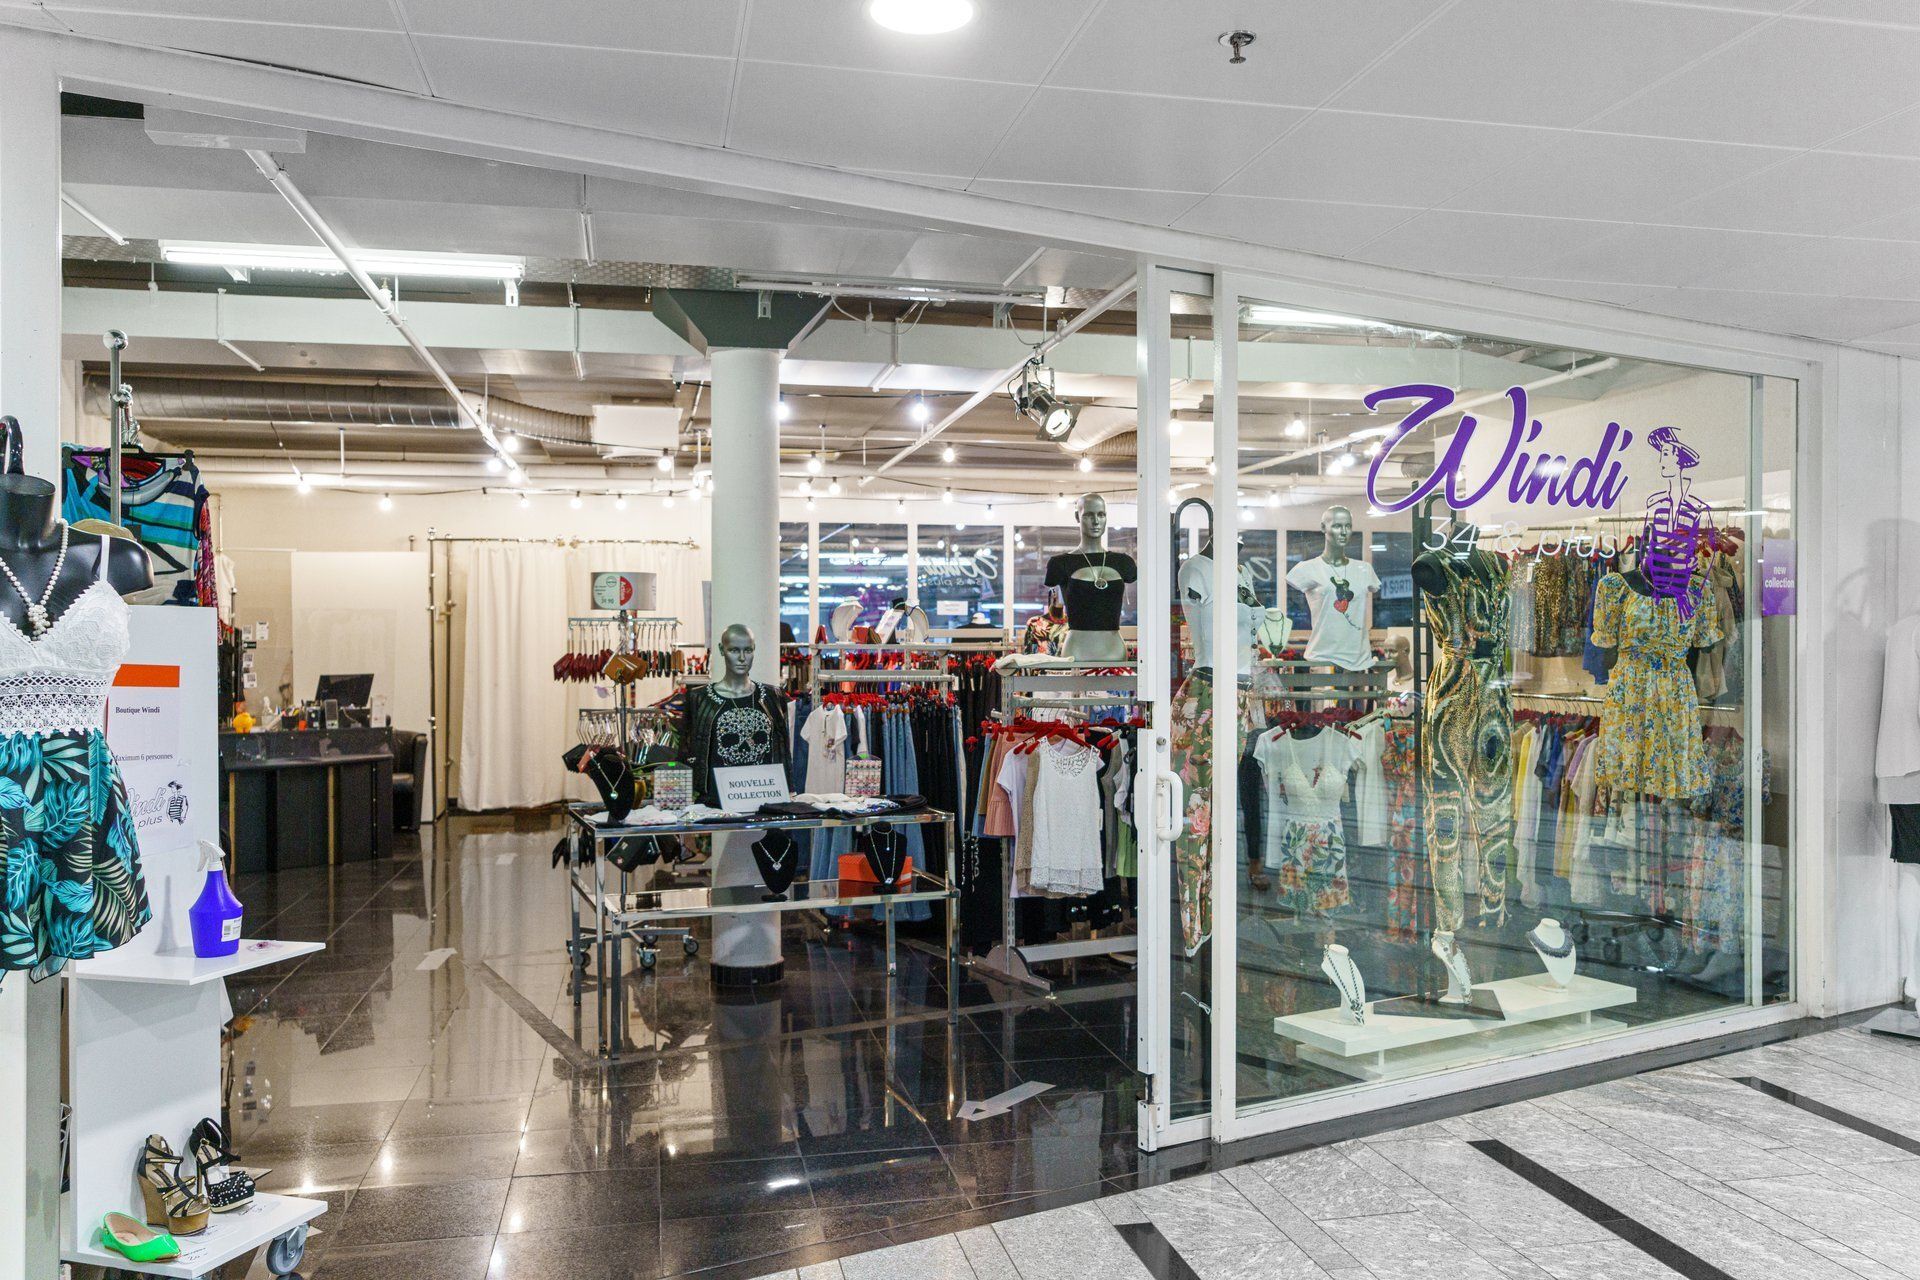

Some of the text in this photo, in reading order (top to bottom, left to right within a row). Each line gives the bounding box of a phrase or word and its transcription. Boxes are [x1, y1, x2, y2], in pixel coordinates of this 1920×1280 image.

[1421, 516, 1619, 562] 34 & plus
[1773, 566, 1787, 575] new
[1764, 576, 1796, 588] collection
[115, 706, 160, 715] Boutique Windi
[145, 753, 173, 762] personnes
[729, 778, 775, 788] NOUVELLE
[728, 790, 781, 800] COLLECTION
[136, 815, 163, 830] plus
